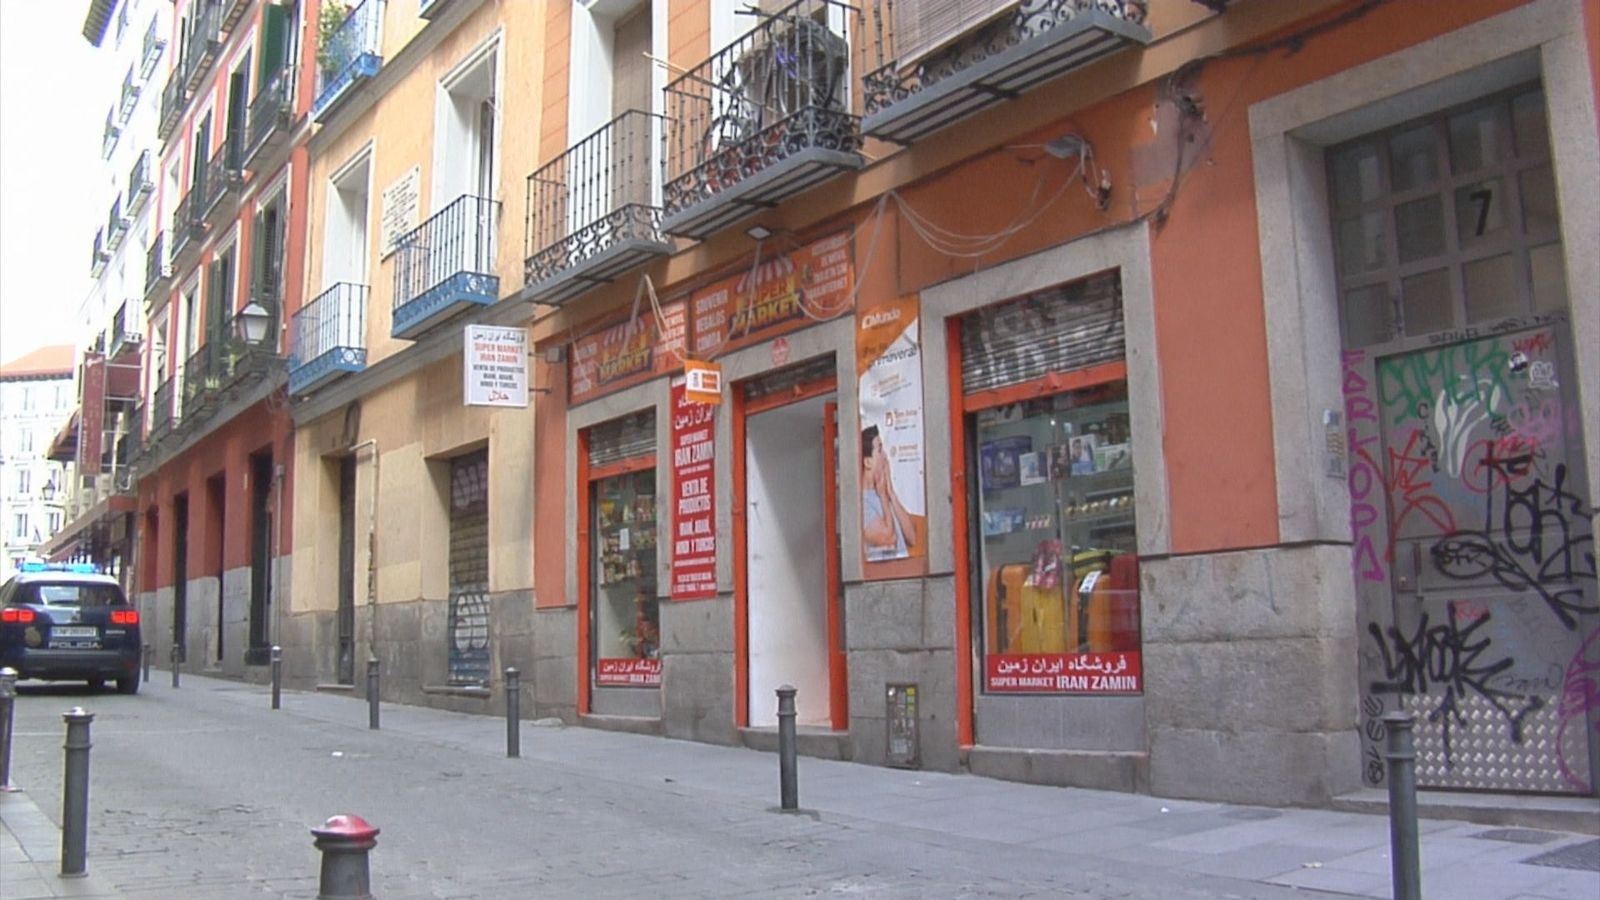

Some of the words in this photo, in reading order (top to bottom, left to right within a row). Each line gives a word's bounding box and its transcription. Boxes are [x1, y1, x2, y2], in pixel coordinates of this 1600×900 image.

[1470, 189, 1492, 236] 7
[733, 291, 801, 336] MARKET
[474, 342, 495, 352] SUPER
[497, 344, 523, 354] MARKET
[480, 353, 495, 362] IRAN
[497, 354, 518, 363] ZAMIN
[488, 390, 509, 402] حلال
[675, 445, 691, 467] IRAN
[691, 441, 713, 463] ZAMIN
[48, 641, 99, 649] POLICIA
[998, 657, 1028, 673] زمین
[1031, 658, 1063, 673] ایران
[1068, 655, 1127, 673] فروشگاه
[991, 676, 1017, 687] SUPER
[1018, 676, 1054, 688] MARKET
[1057, 675, 1088, 689] IRAN
[1091, 675, 1136, 690] ZAMIN
